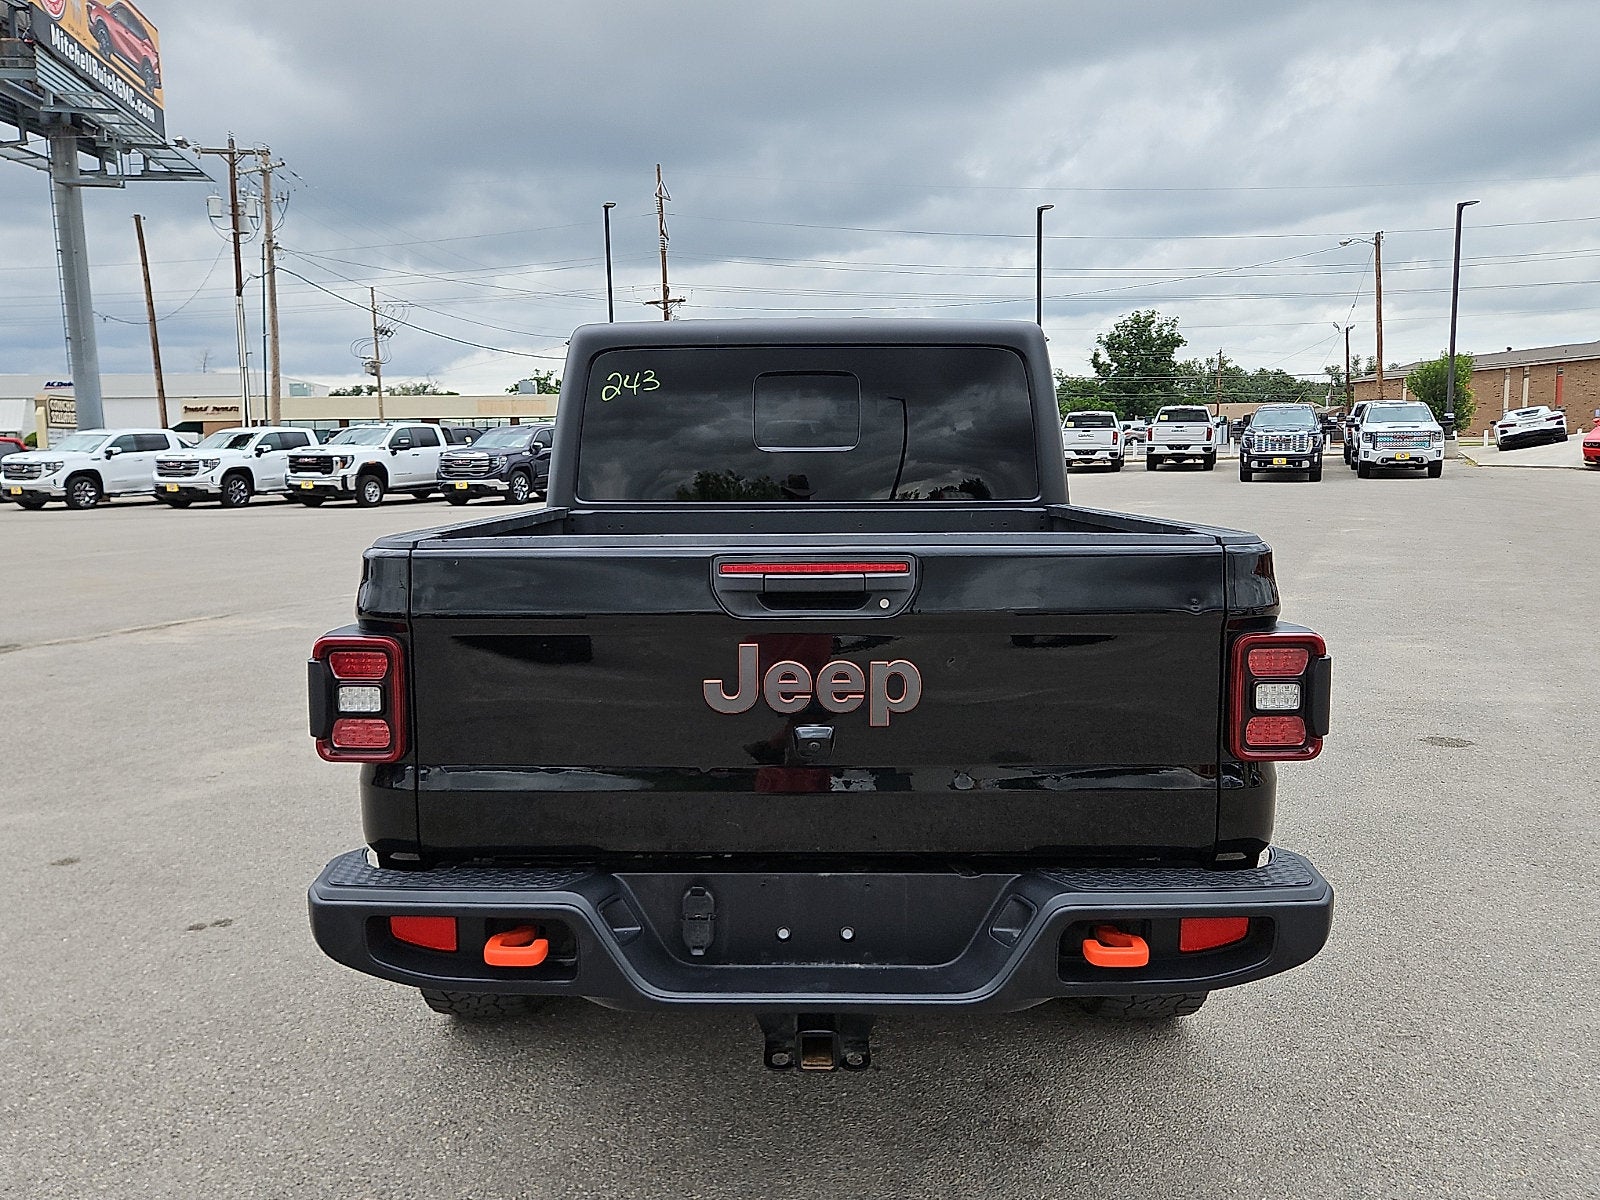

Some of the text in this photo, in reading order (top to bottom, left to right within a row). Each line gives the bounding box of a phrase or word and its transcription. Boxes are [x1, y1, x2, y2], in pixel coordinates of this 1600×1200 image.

[50, 23, 156, 123] MitchellBuickGMC.com
[601, 370, 661, 401] 243
[703, 643, 922, 727] Jeep
